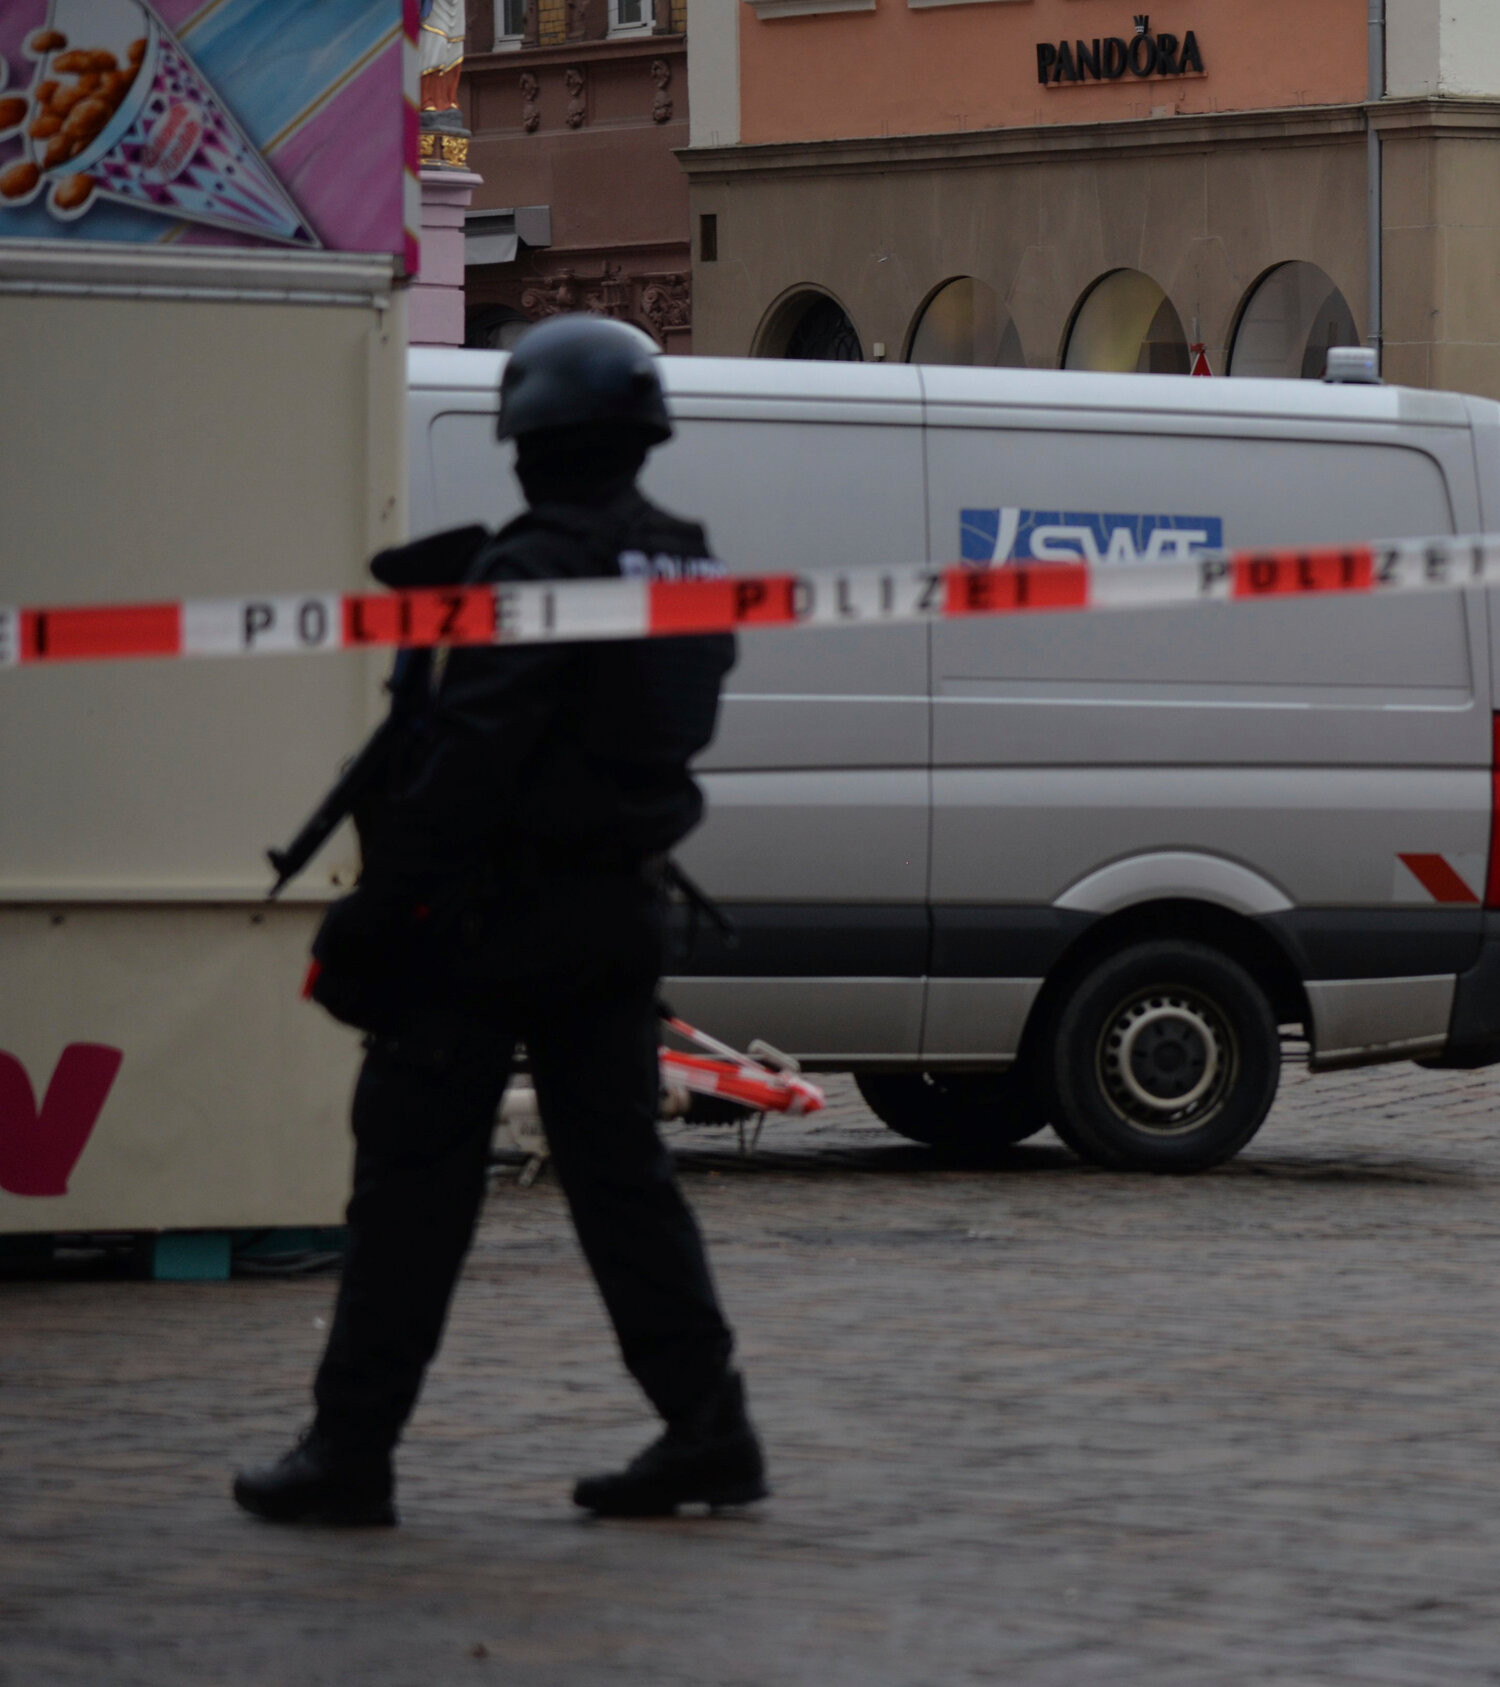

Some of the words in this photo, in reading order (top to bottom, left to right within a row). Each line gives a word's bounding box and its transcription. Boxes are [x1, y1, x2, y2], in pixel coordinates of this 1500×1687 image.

[1036, 29, 1204, 84] PANDORA
[243, 590, 557, 648] POLIZEI
[733, 570, 1030, 619] POLIZEI
[1200, 546, 1484, 593] POLIZEI
